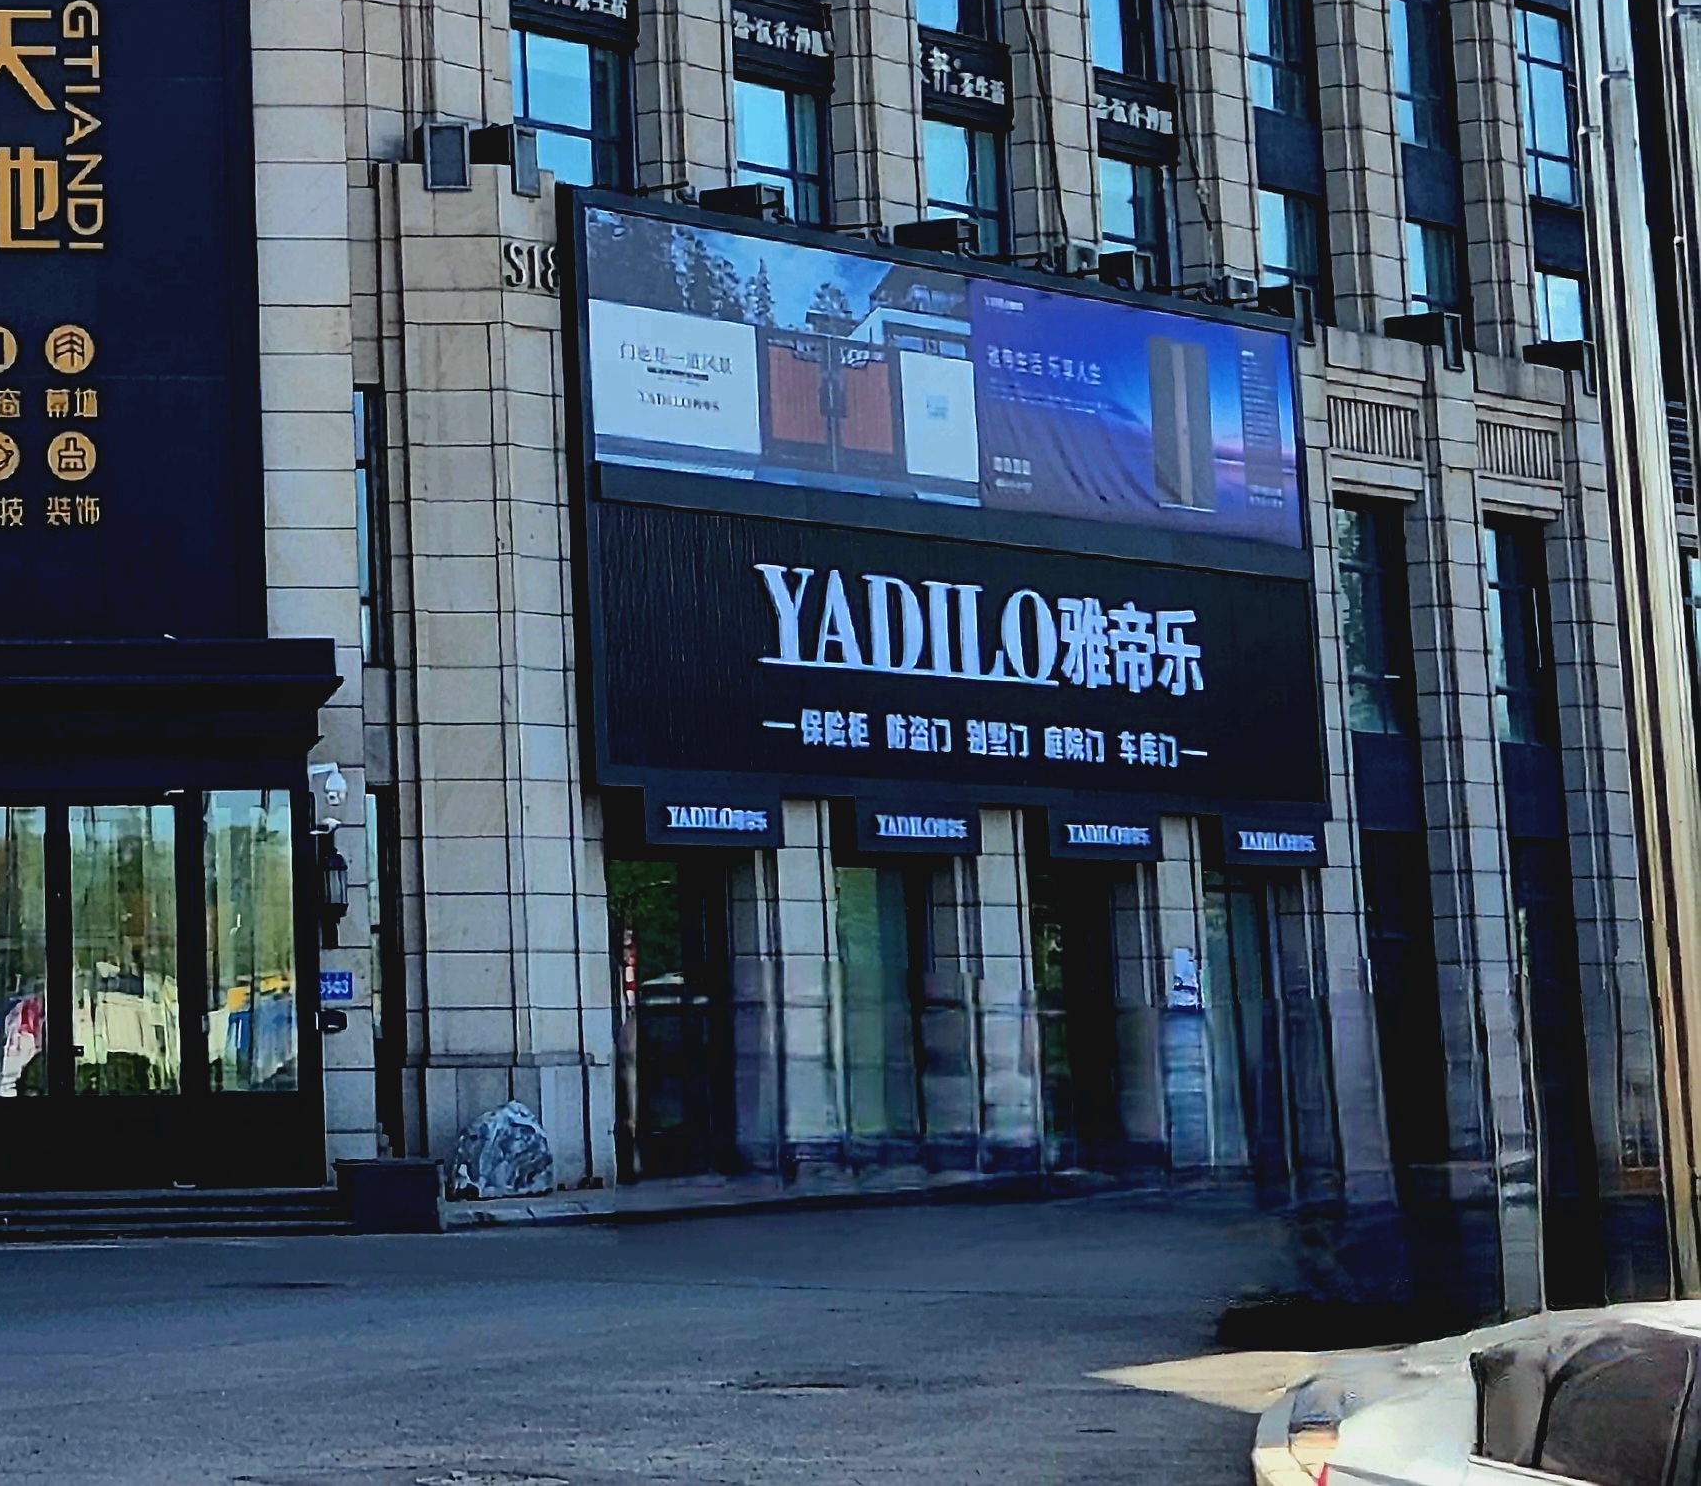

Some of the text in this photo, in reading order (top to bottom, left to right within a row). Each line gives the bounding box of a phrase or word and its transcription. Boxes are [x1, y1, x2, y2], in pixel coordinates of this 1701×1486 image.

[46, 494, 100, 526] 装饰
[1057, 597, 1205, 696] 雅帝乐
[886, 713, 952, 753] 防盗门
[1117, 730, 1179, 768] 车库门
